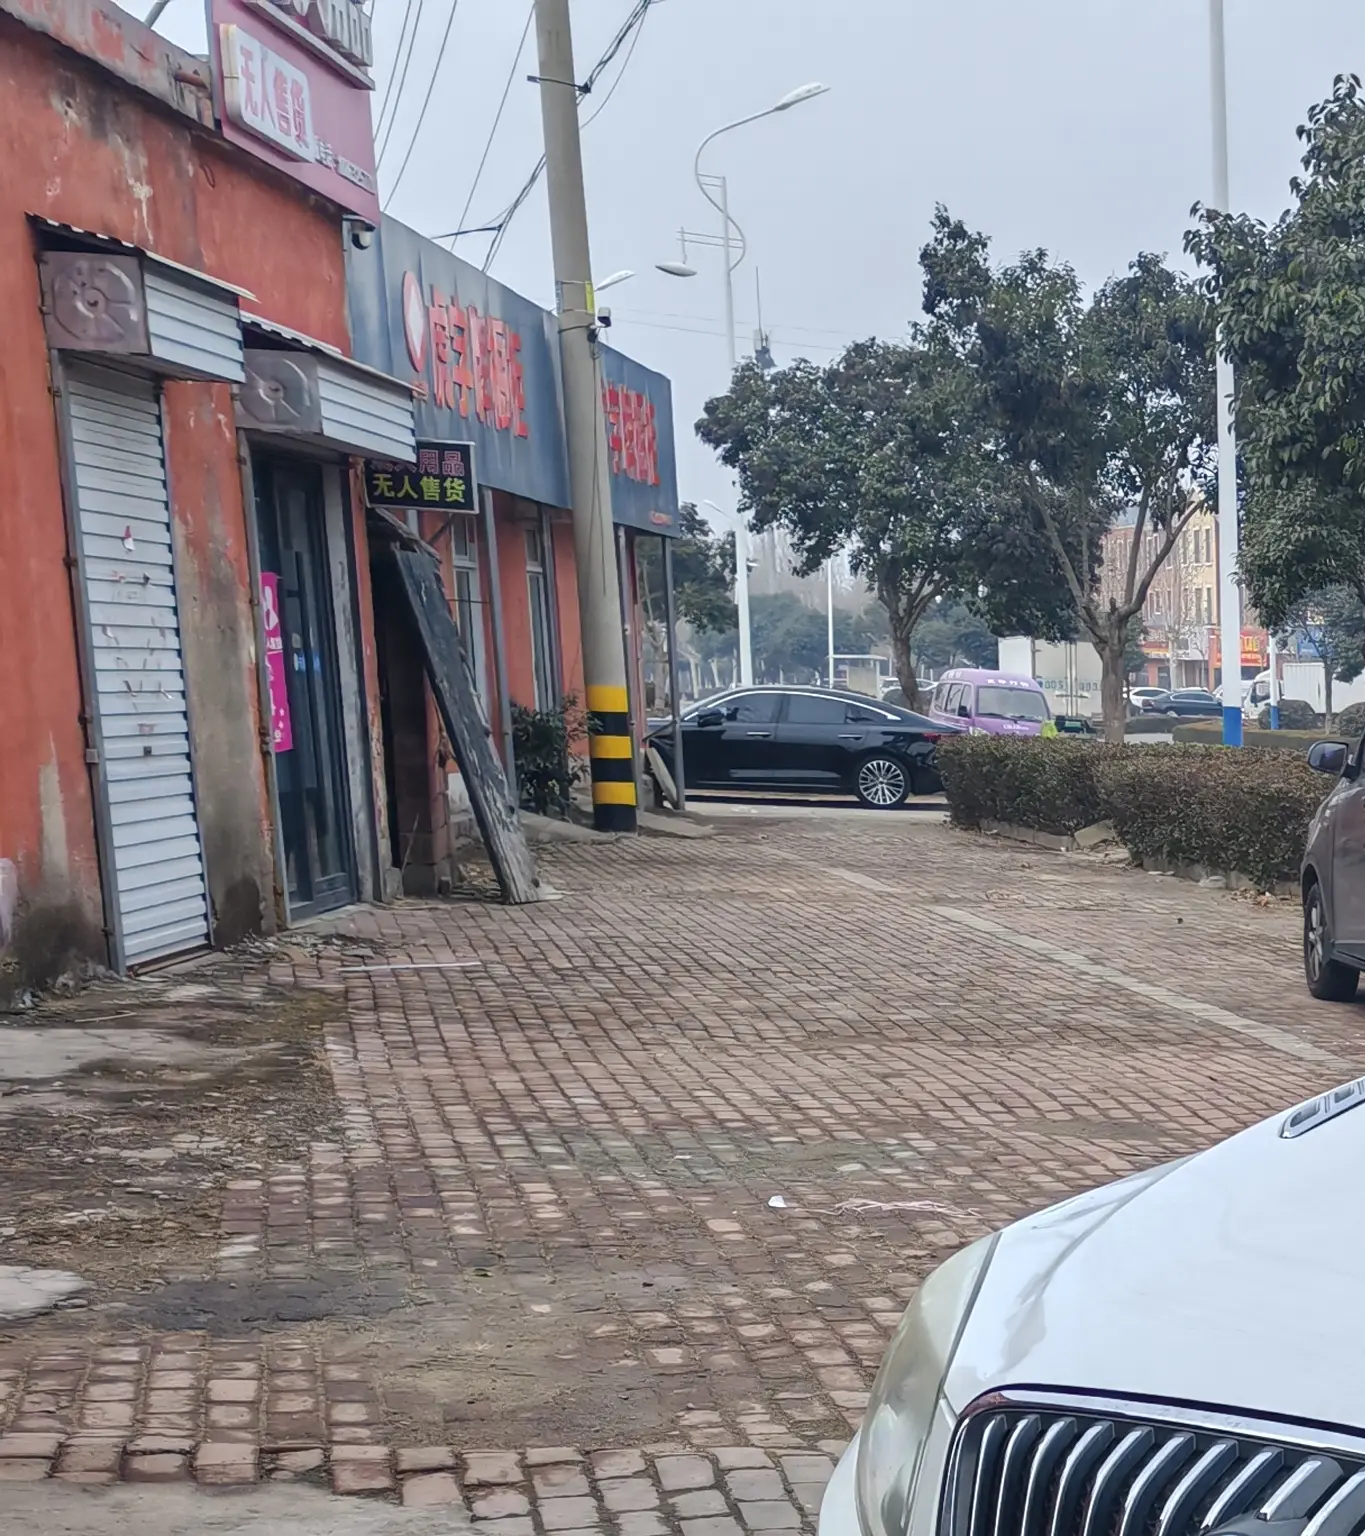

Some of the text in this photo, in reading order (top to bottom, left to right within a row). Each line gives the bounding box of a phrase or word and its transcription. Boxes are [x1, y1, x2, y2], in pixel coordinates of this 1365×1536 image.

[239, 44, 310, 150] 无人售货
[372, 473, 466, 503] 无人售货
